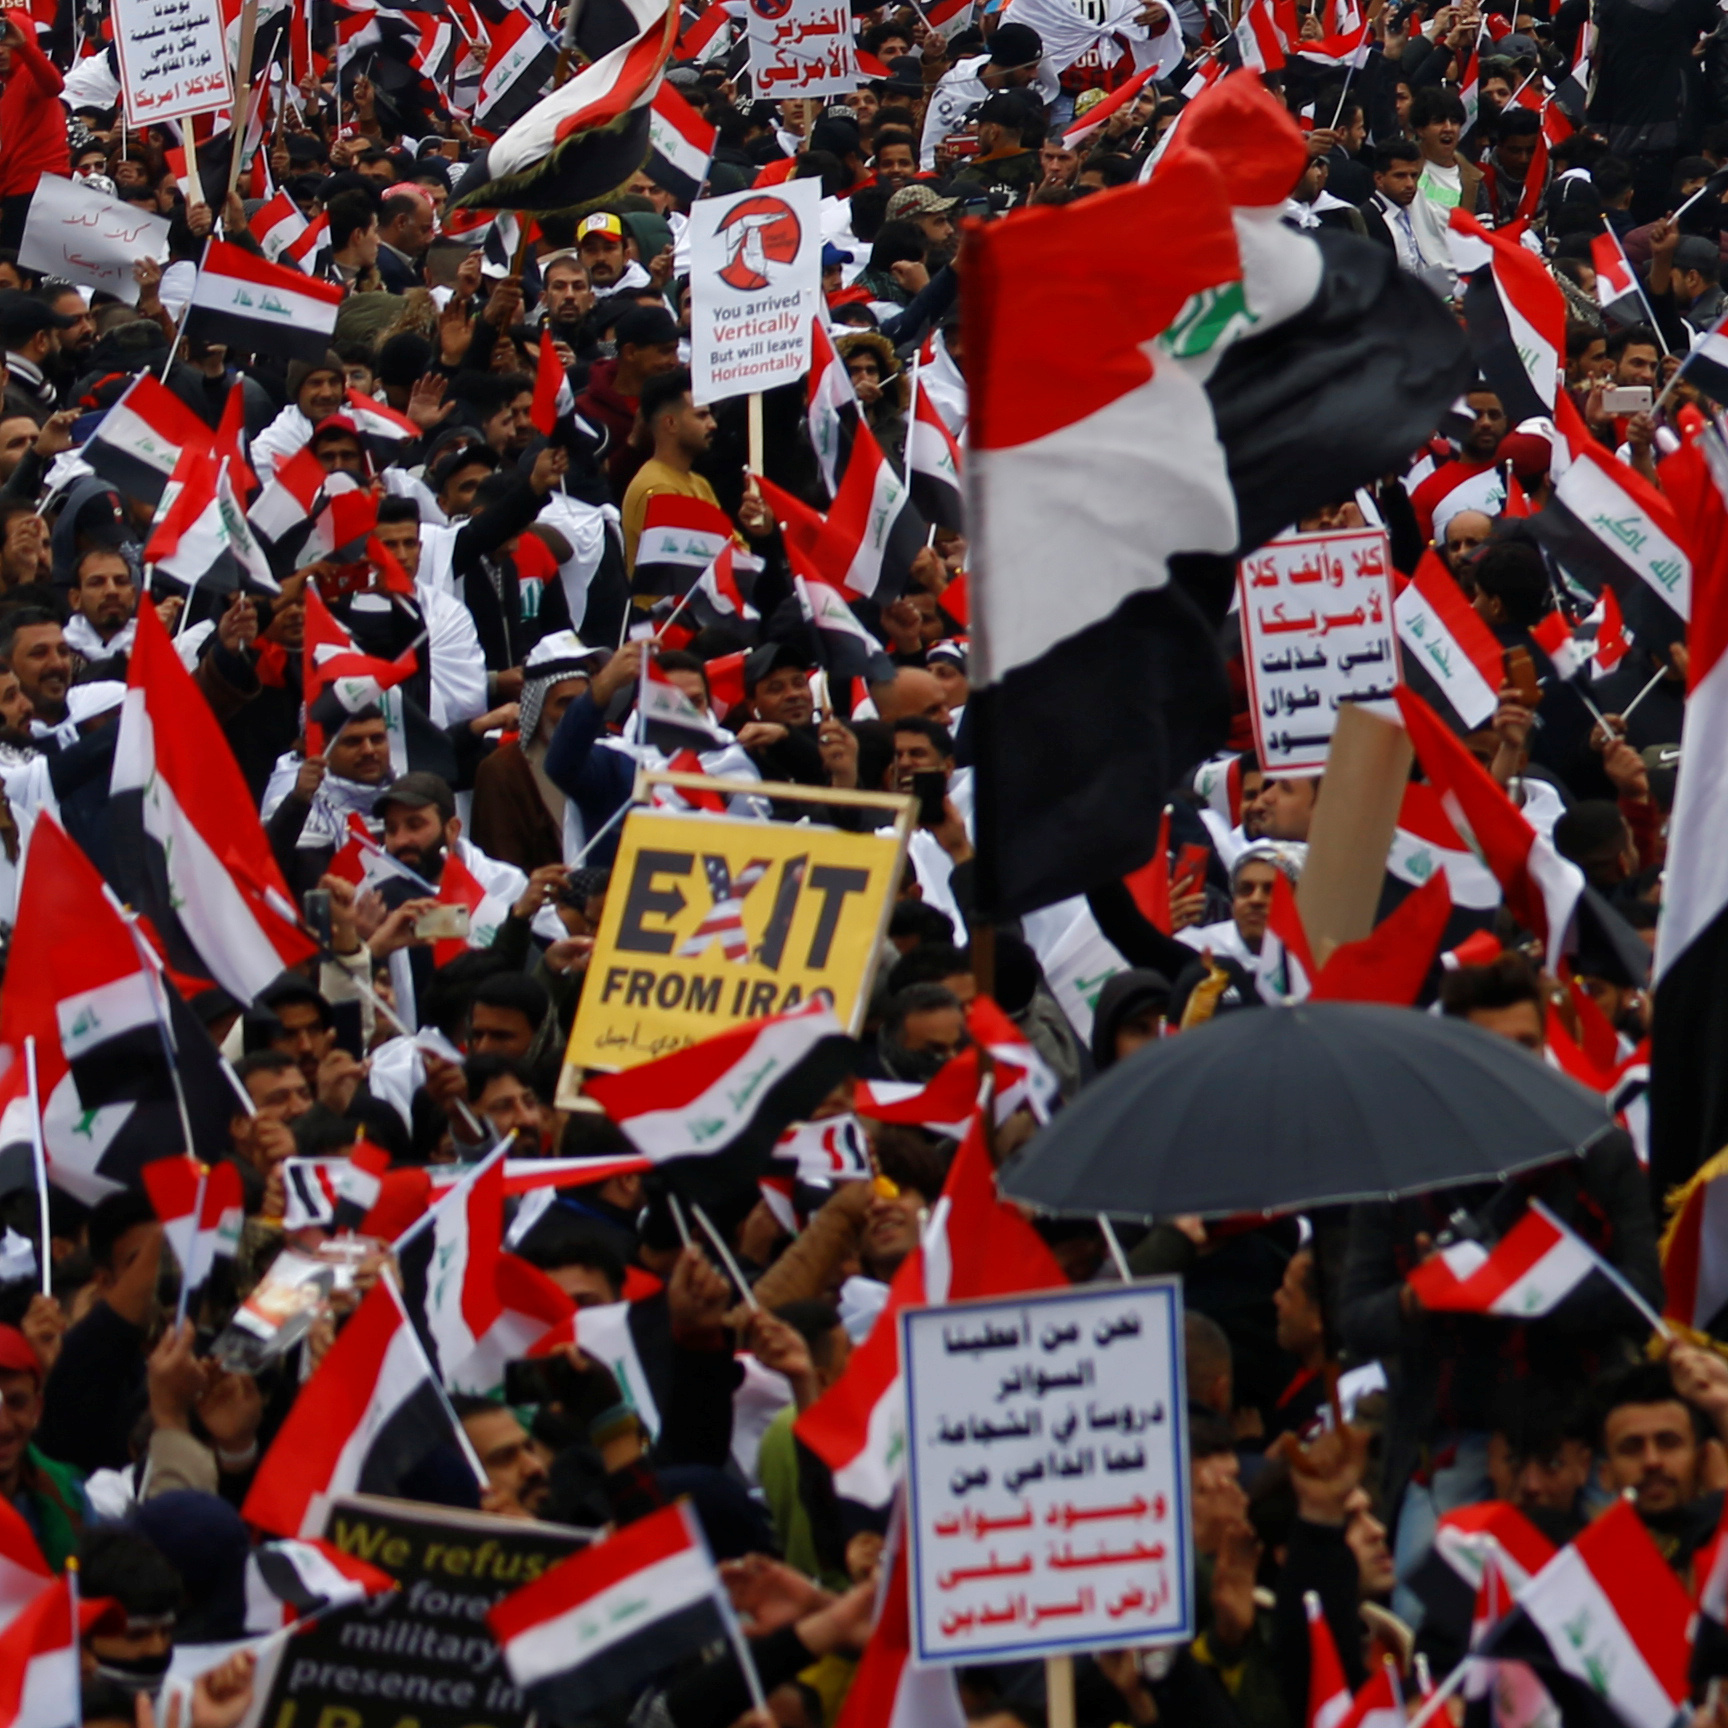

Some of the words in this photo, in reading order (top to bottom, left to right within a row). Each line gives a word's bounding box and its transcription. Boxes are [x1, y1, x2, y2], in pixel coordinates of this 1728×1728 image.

[770, 7, 847, 46] الخنزير
[757, 37, 848, 97] الأمريكي
[713, 306, 742, 322] You
[746, 291, 800, 316] arrived
[713, 312, 800, 344] Vertically
[711, 348, 734, 365] But
[737, 341, 763, 360] will
[768, 336, 803, 354] leave
[711, 353, 803, 384] Horizontally
[1248, 554, 1279, 588] كلا
[1288, 541, 1344, 589] وألف
[1351, 545, 1384, 578] كلا
[1258, 587, 1384, 638] لأمريكا
[1261, 644, 1328, 673] خذلت
[1337, 638, 1391, 678] التي
[1262, 684, 1320, 718] طوال
[614, 848, 871, 975] EXIT
[601, 967, 724, 1015] FROM
[943, 1308, 1031, 1361] أعطينا
[1040, 1321, 1079, 1353] من
[1054, 1402, 1078, 1445] في
[950, 1465, 989, 1497] من
[934, 1498, 1034, 1541] قوات
[1045, 1491, 1167, 1531] وجود
[335, 1521, 410, 1566] We
[424, 1540, 566, 1582] refus
[936, 1549, 1033, 1592] على
[1047, 1540, 1166, 1572] محتلة
[408, 1580, 504, 1619] fore
[940, 1584, 1095, 1637] الرافدين
[1106, 1568, 1169, 1618] أرض
[340, 1621, 497, 1672] military
[289, 1658, 474, 1708] presence
[486, 1678, 524, 1712] in
